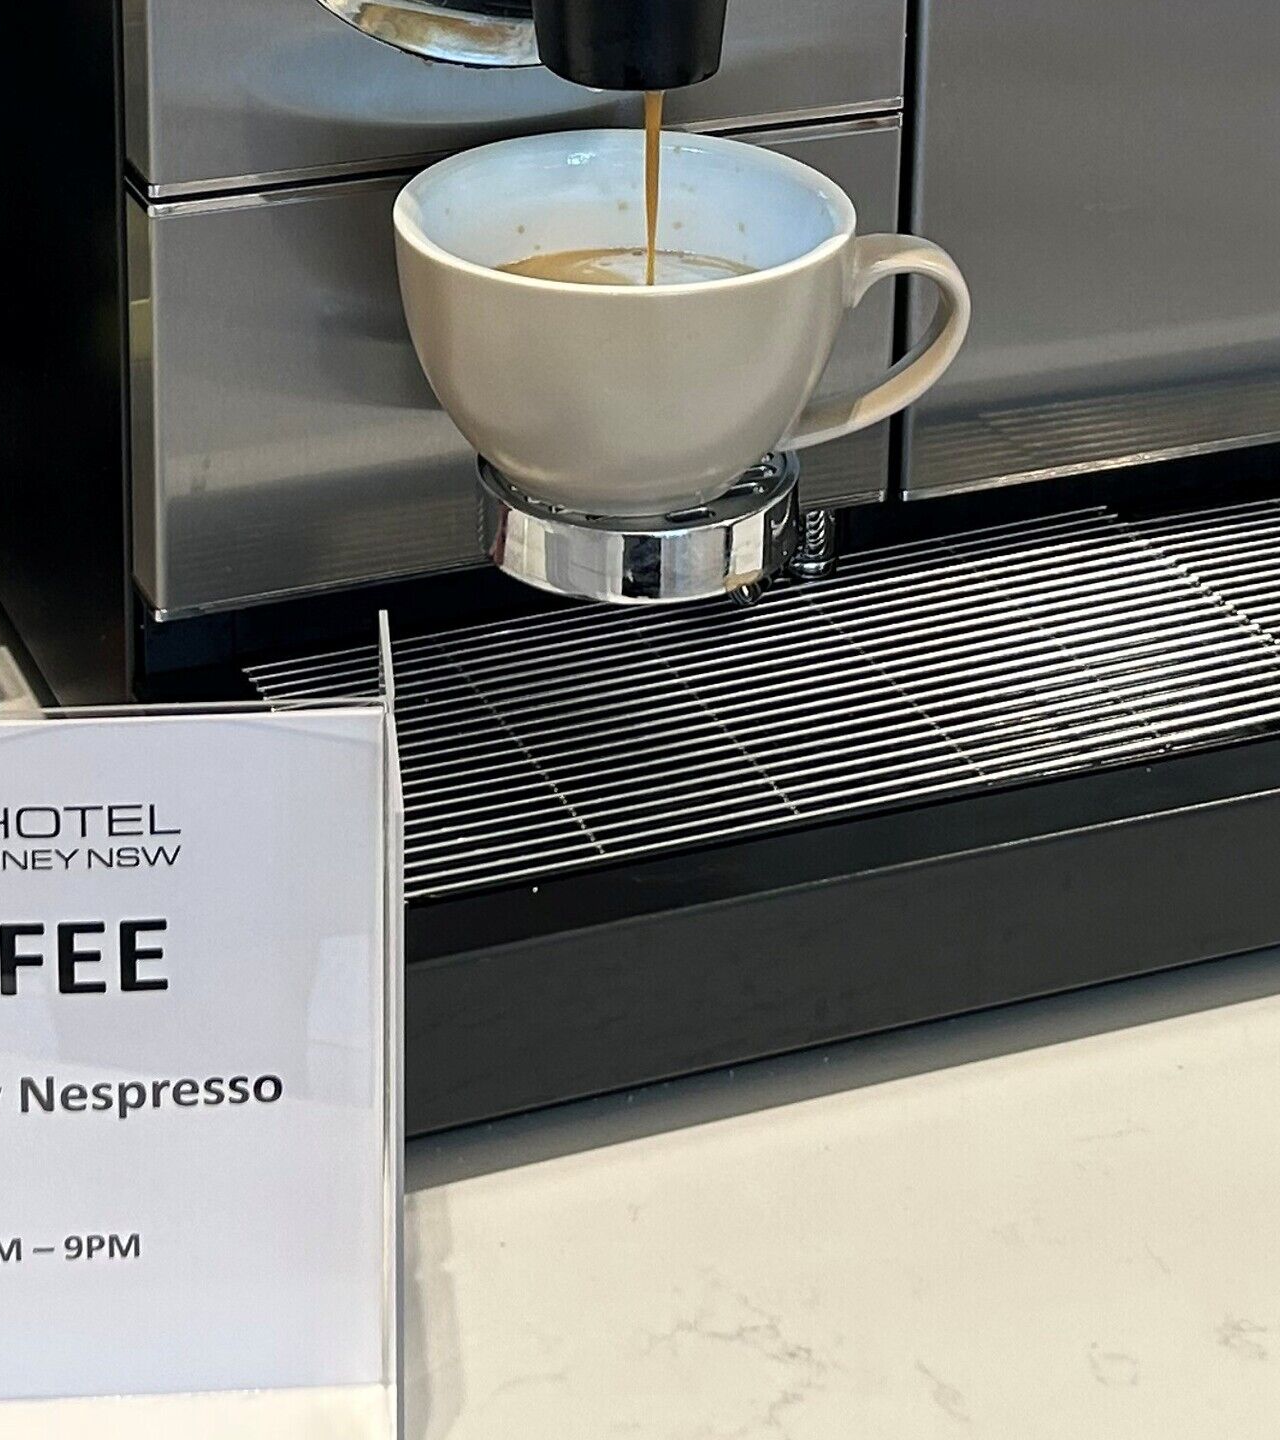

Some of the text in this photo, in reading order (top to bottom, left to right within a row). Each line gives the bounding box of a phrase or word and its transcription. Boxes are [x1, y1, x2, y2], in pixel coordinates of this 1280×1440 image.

[87, 844, 182, 870] NSW
[20, 1071, 283, 1120] Nespresso
[64, 1233, 140, 1260] 9PM
